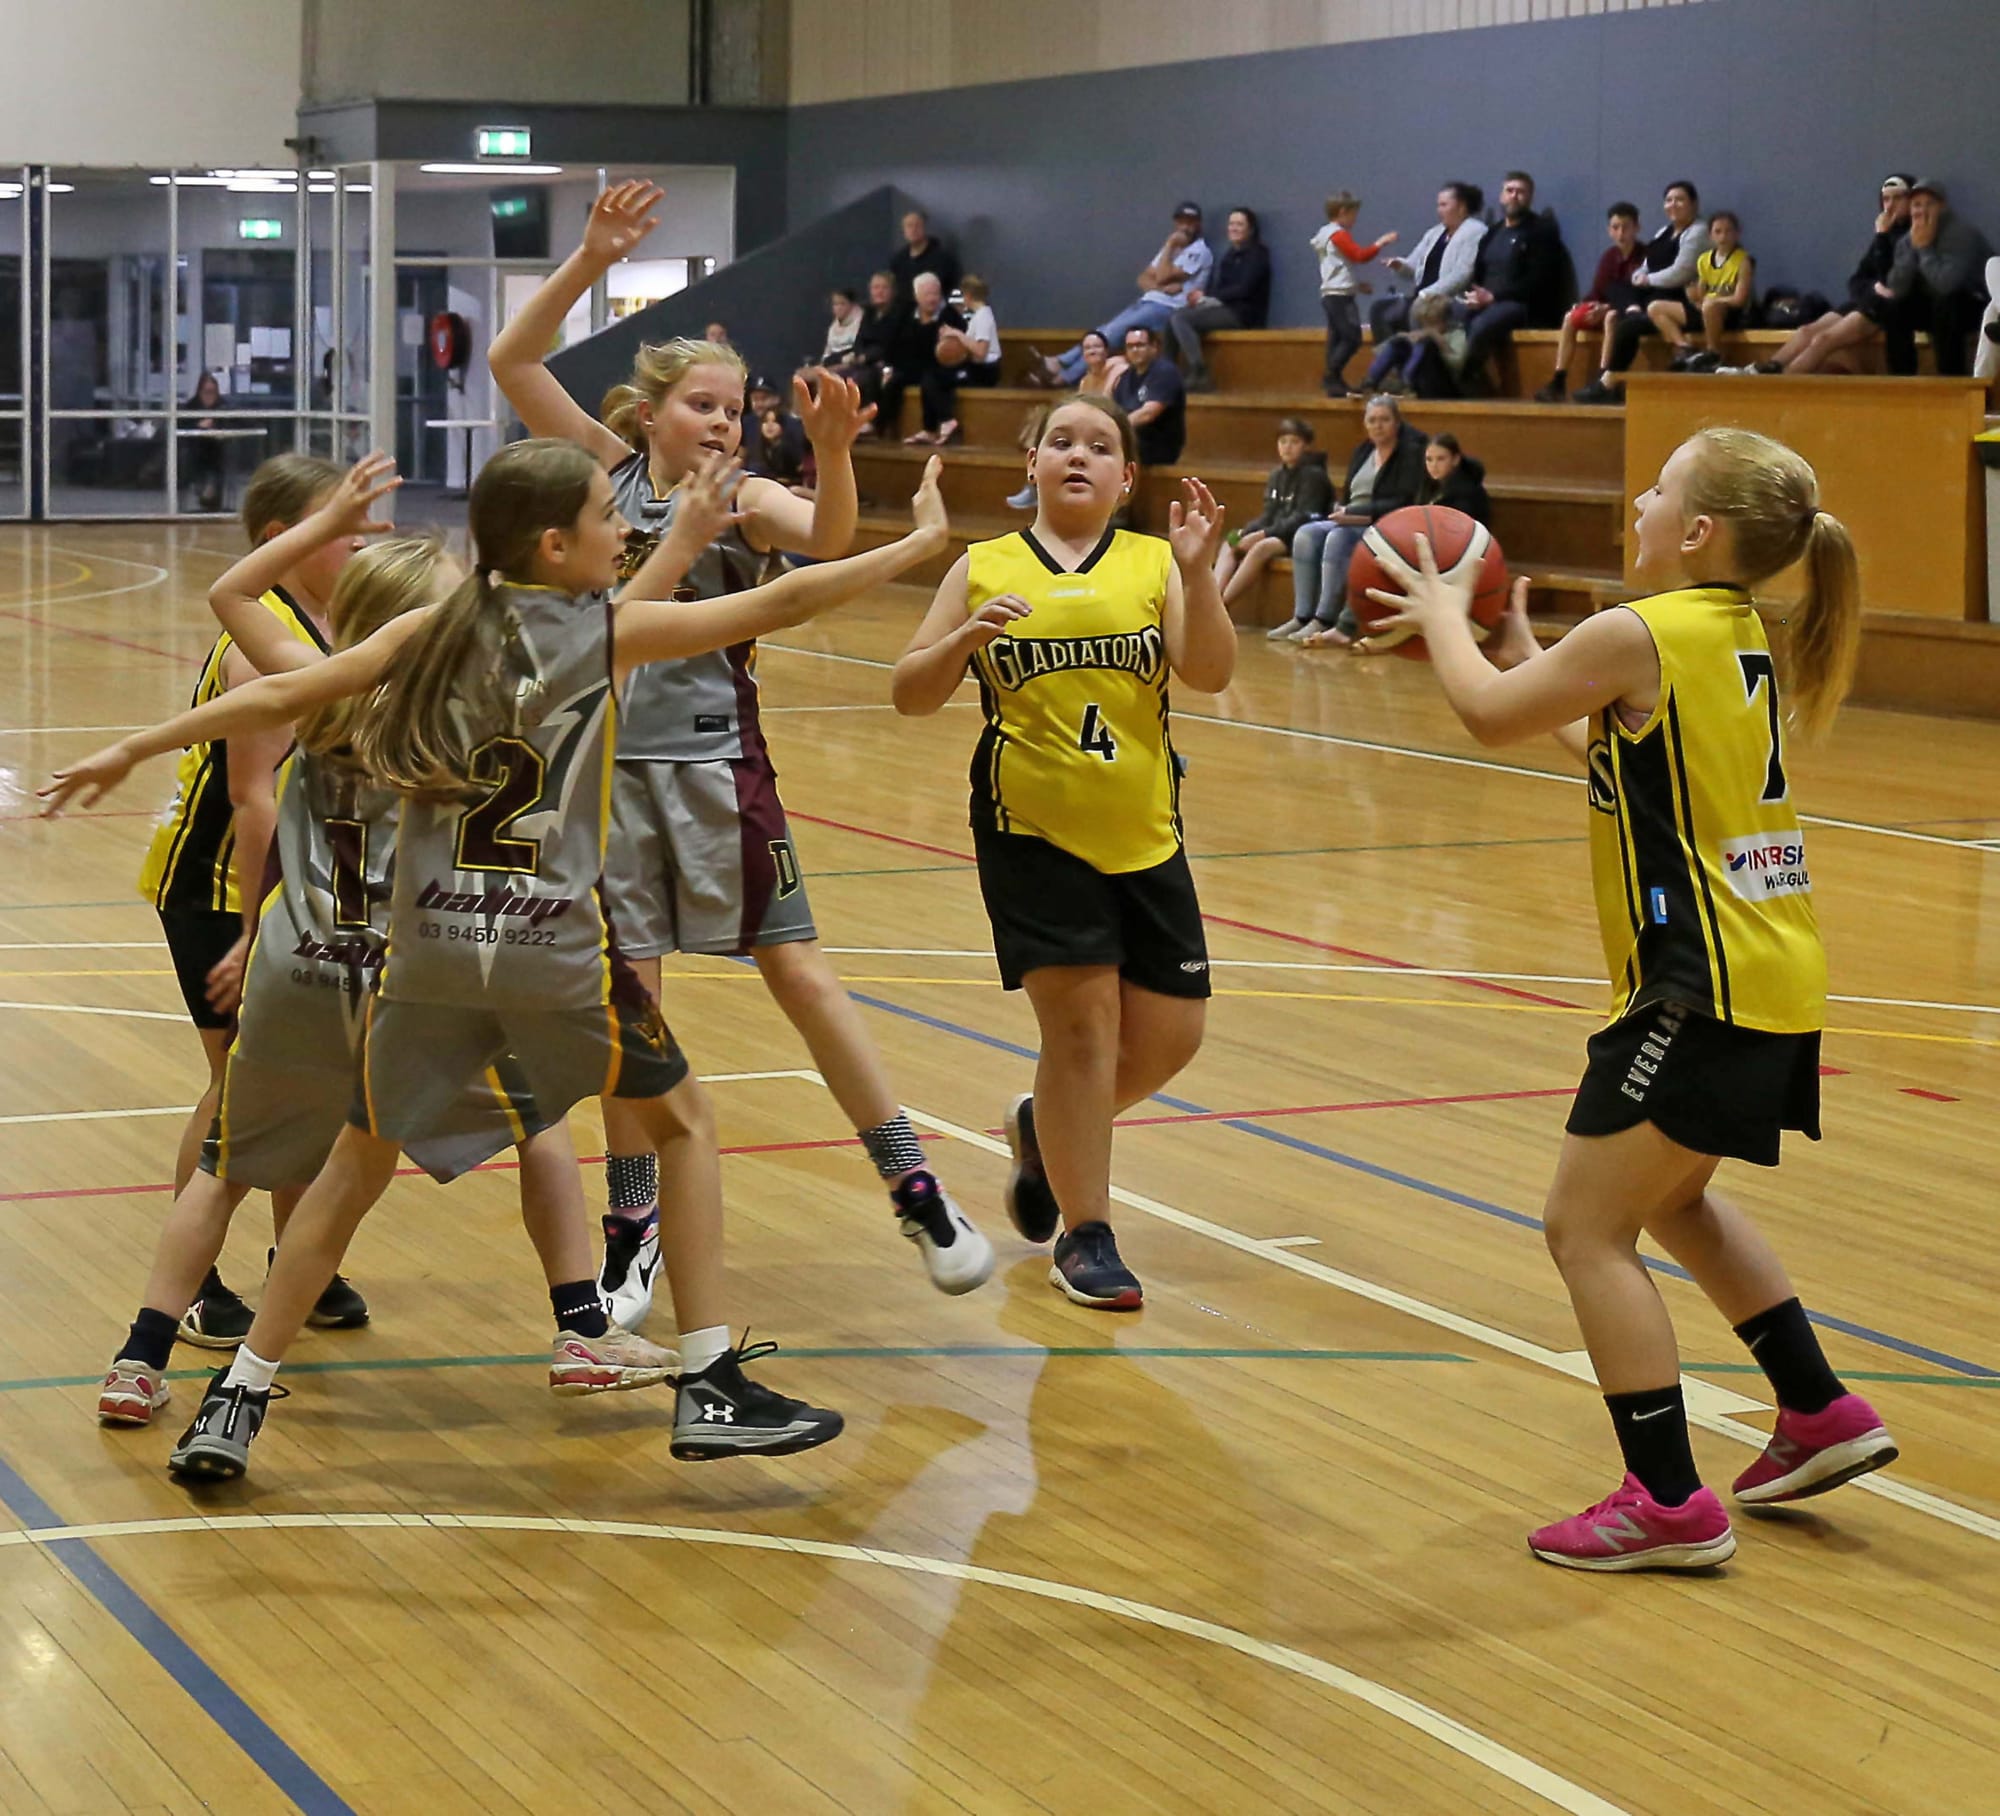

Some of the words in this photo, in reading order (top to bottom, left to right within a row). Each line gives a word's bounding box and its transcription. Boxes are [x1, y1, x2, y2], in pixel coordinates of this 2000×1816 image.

[987, 624, 1162, 692] GLADIATORS
[1078, 703, 1117, 763] 4
[1736, 651, 1787, 804] 7
[453, 733, 548, 877] 2
[768, 839, 800, 901] D
[419, 921, 442, 939] 03
[447, 924, 499, 945] 9450
[505, 929, 557, 946] 9222
[1620, 1001, 1688, 1102] EVERLAS
